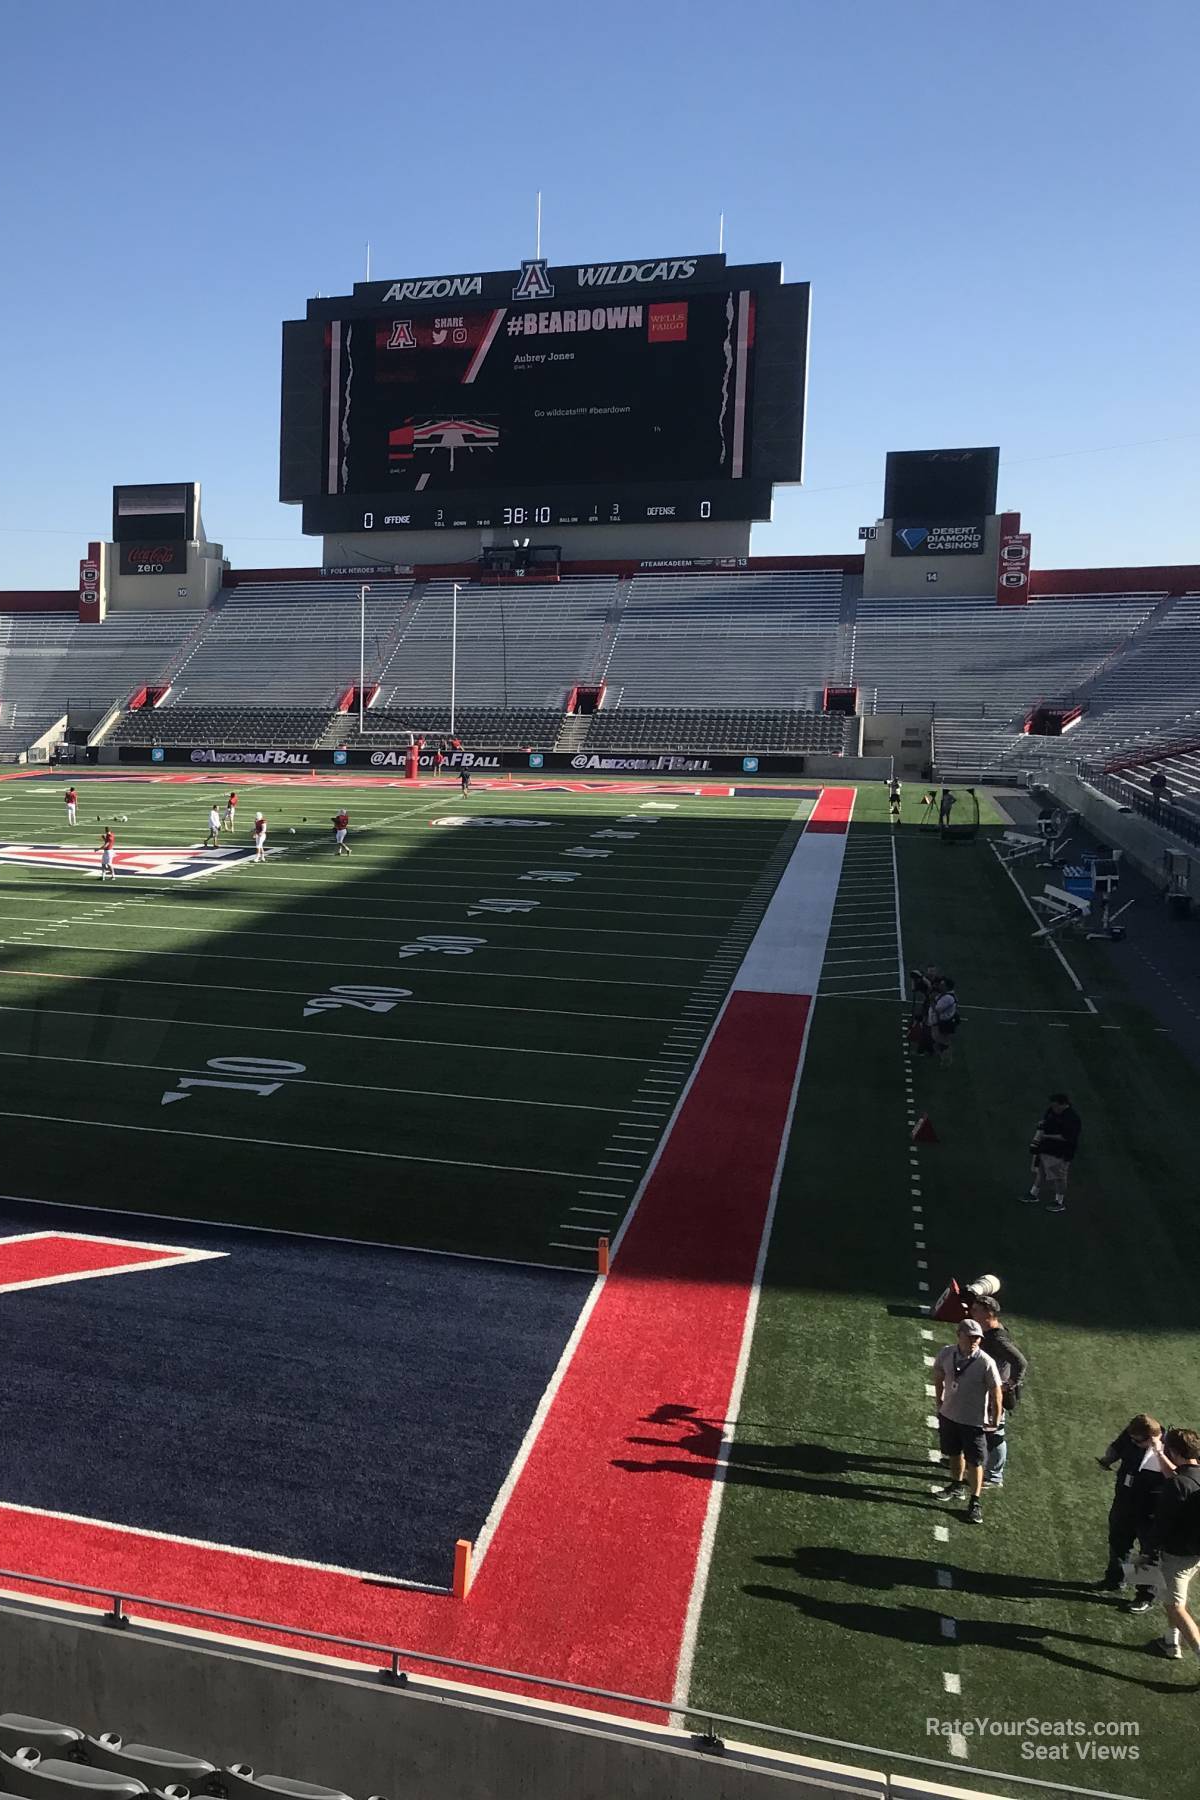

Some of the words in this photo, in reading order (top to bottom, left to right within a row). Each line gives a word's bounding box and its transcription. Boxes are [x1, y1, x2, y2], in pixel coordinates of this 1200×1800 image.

[577, 259, 698, 287] WILDCATS
[382, 276, 482, 302] ARIZONA
[434, 317, 464, 328] SHARE
[507, 305, 643, 336] #BEARDOWN
[651, 314, 685, 323] WELLS
[652, 322, 684, 331] FARGO
[513, 353, 546, 364] Aubrey
[547, 351, 575, 361] Jones
[534, 409, 545, 417] Go
[589, 405, 631, 415] #beardown
[437, 509, 444, 520] 3
[613, 503, 619, 515] 3
[647, 506, 676, 516] DEFENSE
[701, 501, 711, 518] 0
[363, 512, 374, 529] 0
[384, 515, 411, 525] OFFENSE
[503, 507, 550, 524] 38:10
[860, 529, 876, 539] 40
[933, 527, 976, 535] DESERT
[927, 534, 981, 542] DIAMOND
[137, 564, 163, 573] zero
[927, 573, 937, 581] 14
[178, 588, 187, 597] 10
[469, 899, 541, 913] 40
[400, 935, 488, 955] 30
[307, 985, 413, 1013] 20
[177, 1057, 306, 1096] 10
